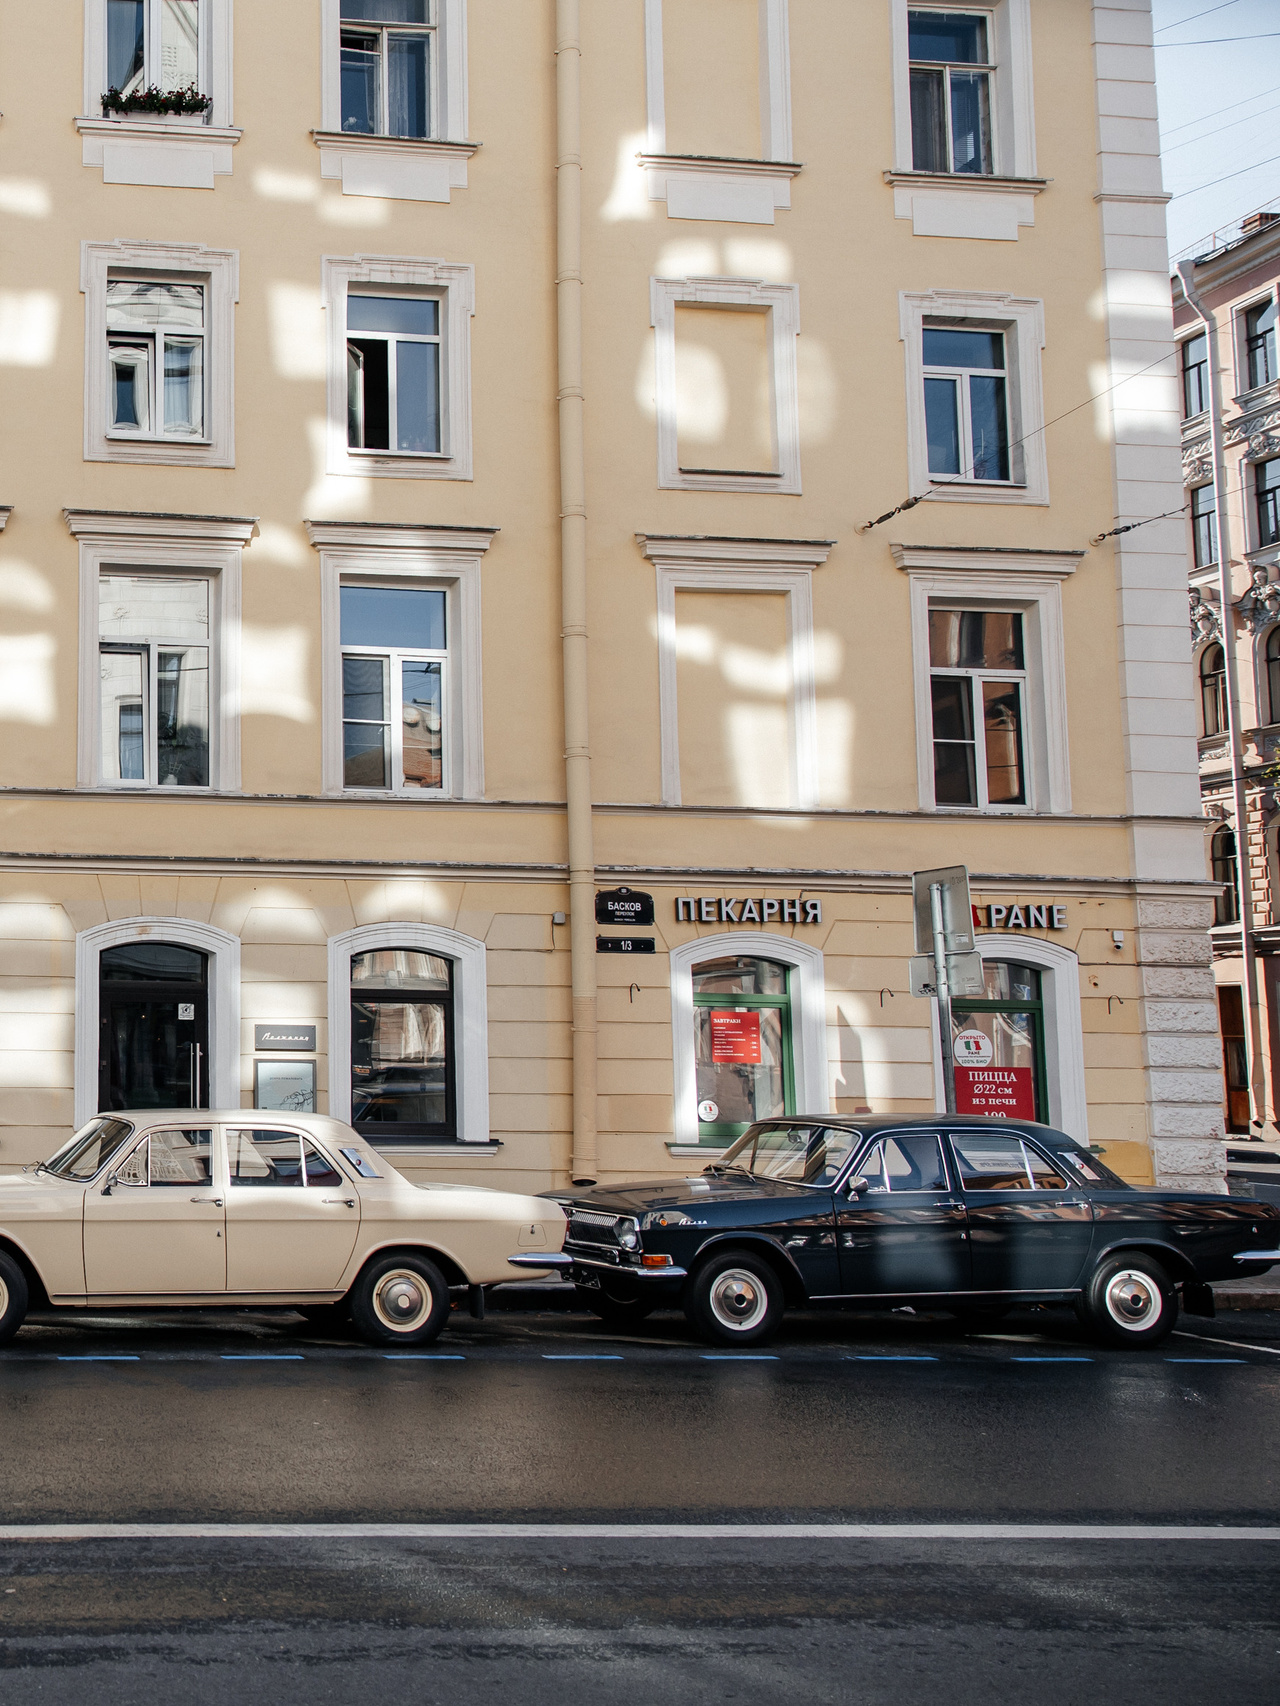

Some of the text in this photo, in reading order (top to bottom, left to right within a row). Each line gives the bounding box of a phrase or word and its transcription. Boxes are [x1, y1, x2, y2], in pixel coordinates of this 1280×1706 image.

[607, 901, 642, 911] БАСКОВ
[676, 897, 822, 923] ПЕКАРНЯ
[988, 904, 1068, 928] PANE
[620, 940, 632, 951] 1/3
[968, 1071, 1017, 1084] ПИЦЦА
